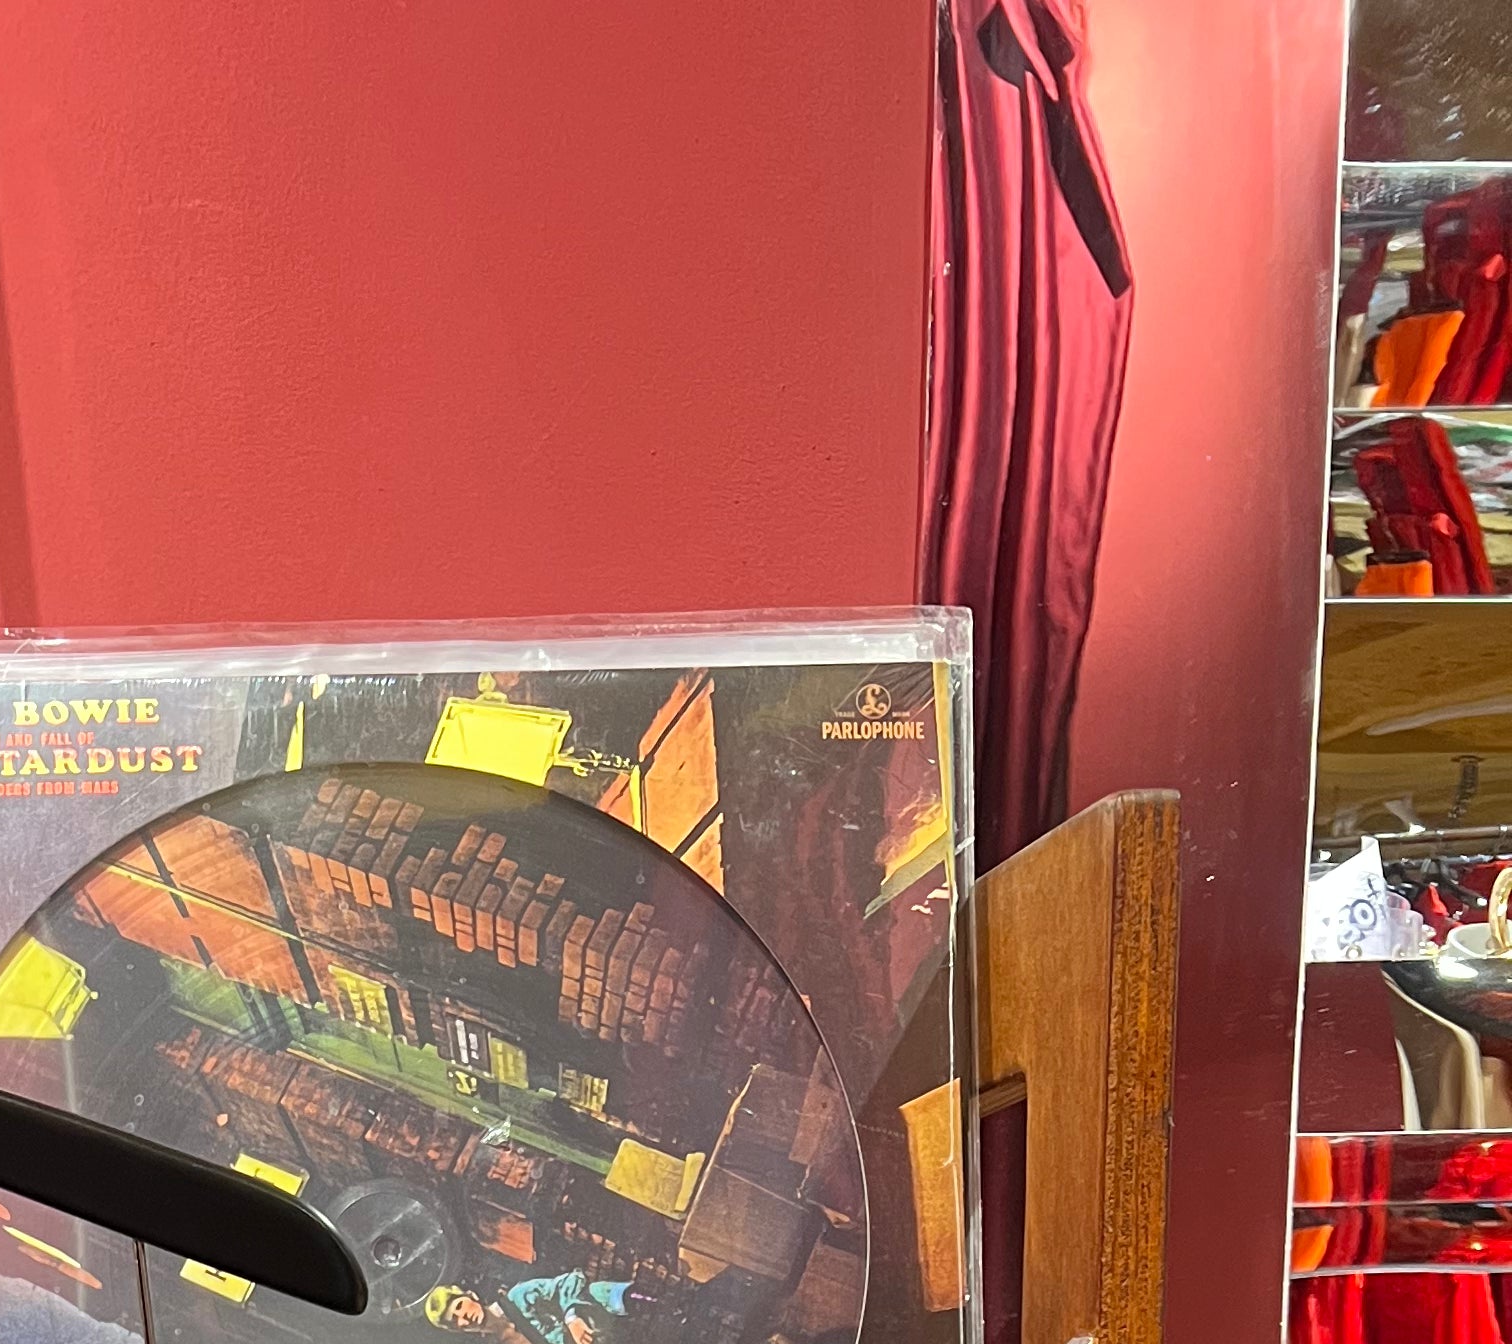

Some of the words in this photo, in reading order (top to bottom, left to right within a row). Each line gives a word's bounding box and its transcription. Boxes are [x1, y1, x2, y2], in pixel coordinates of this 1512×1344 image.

[14, 698, 160, 726] BOWIE
[6, 733, 33, 747] AND
[40, 732, 72, 746] FALL
[77, 731, 95, 745] OF
[822, 721, 925, 740] PARLOPHONE
[37, 781, 75, 796] FROM
[80, 780, 119, 795] MARS
